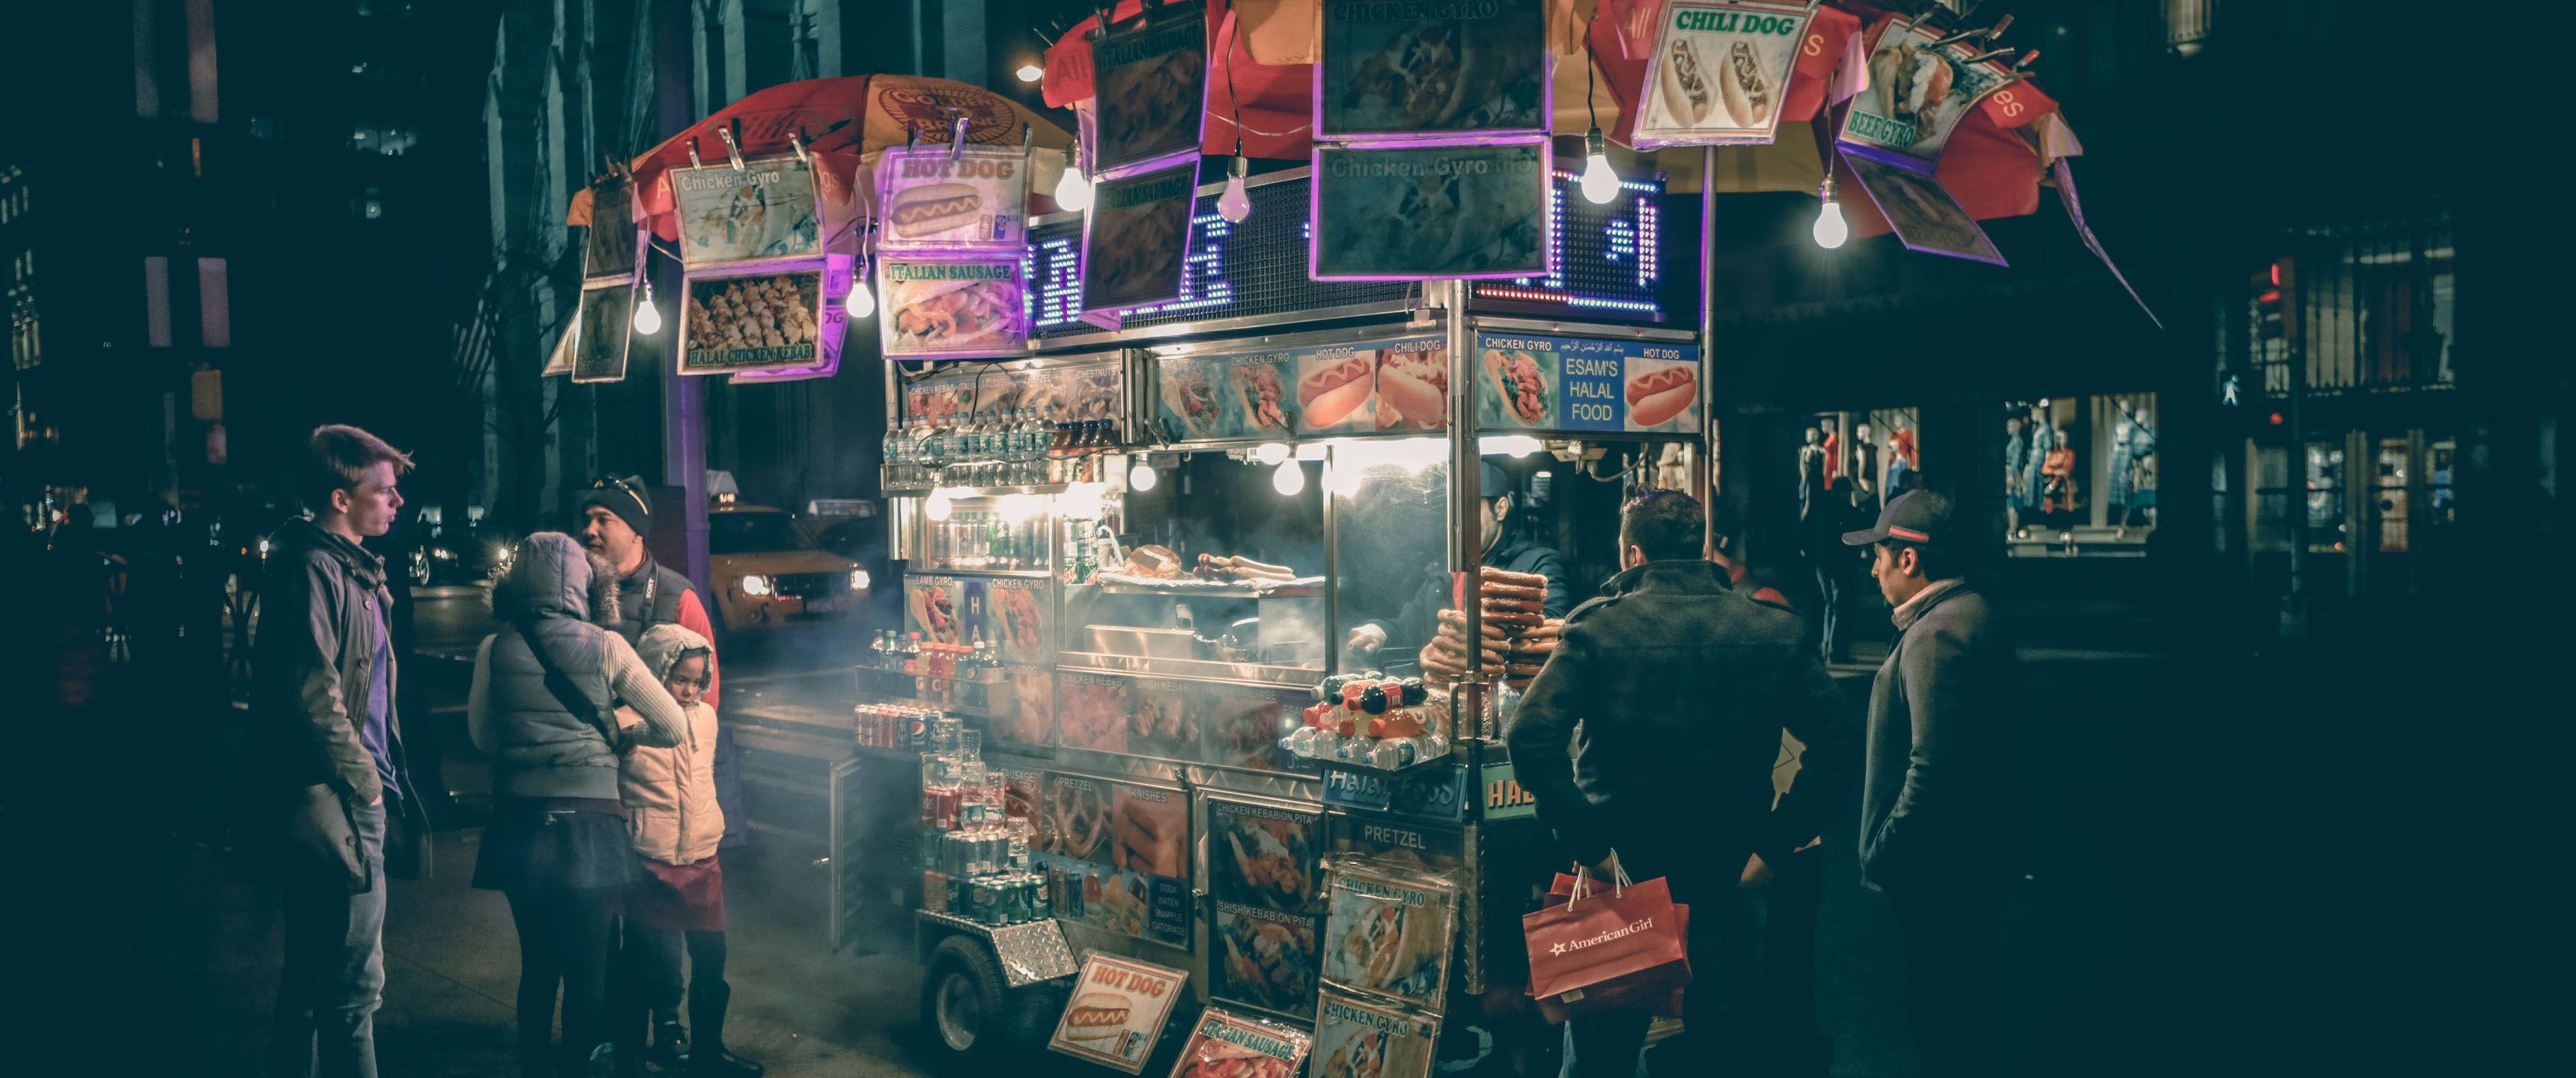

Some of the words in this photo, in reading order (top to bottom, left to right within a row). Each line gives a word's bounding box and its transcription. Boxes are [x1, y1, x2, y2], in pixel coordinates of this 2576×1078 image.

[1332, 2, 1428, 22] CHICKEN
[1676, 10, 1737, 32] CHILI
[1740, 15, 1795, 36] DOG
[920, 117, 1001, 132] BRND
[1847, 111, 1879, 138] BEEF
[1880, 118, 1916, 147] GYRO
[902, 159, 953, 179] HOT
[958, 159, 1014, 180] DOG
[1331, 156, 1425, 178] Chicken
[1433, 156, 1489, 180] Gyro
[681, 173, 742, 192] Chicken
[747, 170, 780, 189] Gyro
[889, 265, 947, 281] ITALIAN
[950, 264, 1011, 280] SAUSAGE
[1394, 342, 1418, 353] CHILI
[1420, 340, 1441, 352] DOG
[1485, 337, 1525, 350] CHICKEN
[1527, 339, 1552, 352] GYRO
[689, 347, 727, 365] HALAL
[727, 346, 774, 364] CHICKEN
[775, 344, 813, 360] KEBAB
[1230, 354, 1265, 366] CHICKEN
[1266, 352, 1289, 364] GYRO
[1316, 348, 1333, 360] HOT
[1334, 346, 1355, 359] DOG
[1643, 348, 1660, 359] HOT
[1662, 349, 1680, 360] DOG
[1078, 368, 1115, 379] CHESTNUTS
[1567, 359, 1617, 377] ESAM'S
[935, 383, 954, 393] KEBAB
[1570, 381, 1614, 399] HALAL
[1573, 404, 1612, 421] FOOD
[916, 576, 933, 586] LAMB
[935, 576, 953, 588] GYRO
[991, 578, 1022, 589] CHICKEN
[1024, 579, 1044, 590] GYRO
[1021, 666, 1037, 675] DOG
[1096, 676, 1122, 686] KEBAB
[1137, 680, 1159, 689] SHISH
[1161, 681, 1189, 692] KEBAB
[1236, 688, 1277, 701] SAUSAGE
[1059, 777, 1093, 791] PRETZEL
[1131, 788, 1167, 803] KNISHES
[1216, 803, 1250, 815] CHICKEN
[1252, 808, 1280, 820] KEBAB
[1281, 811, 1293, 821] ON
[1295, 814, 1313, 824] PITA
[1364, 825, 1426, 850] PRETZEL
[1338, 877, 1391, 898] CHICKEN
[1393, 888, 1425, 907] GYRO
[1278, 912, 1291, 925] ON
[1293, 915, 1313, 928] PITA
[1568, 926, 1629, 951] American
[1629, 917, 1653, 934] Girl
[1091, 966, 1129, 988] HOT
[1126, 973, 1167, 998] DOG
[1245, 1033, 1295, 1062] SAUSAGE
